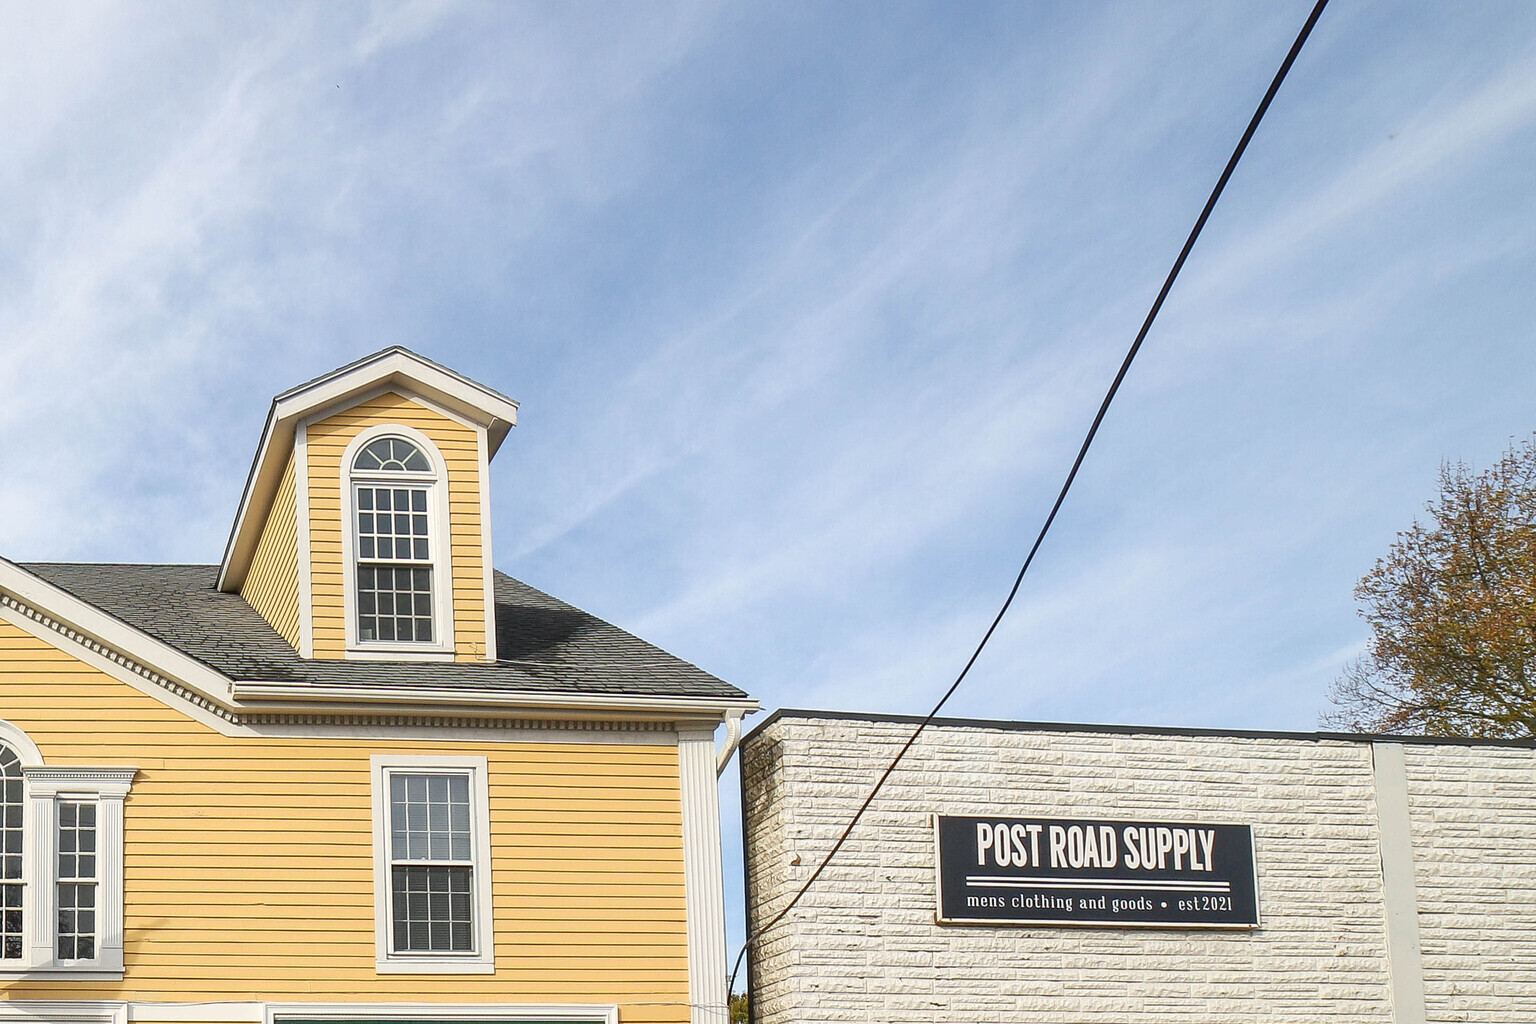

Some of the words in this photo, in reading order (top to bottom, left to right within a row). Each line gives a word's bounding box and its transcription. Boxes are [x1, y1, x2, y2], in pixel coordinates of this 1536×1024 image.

[976, 822, 1042, 867] POST
[1049, 825, 1117, 869] ROAD
[1123, 826, 1216, 872] SUPPLY
[967, 894, 1005, 908] mens
[1011, 894, 1073, 912] clothing
[1079, 895, 1106, 910] and
[1112, 895, 1153, 913] goods
